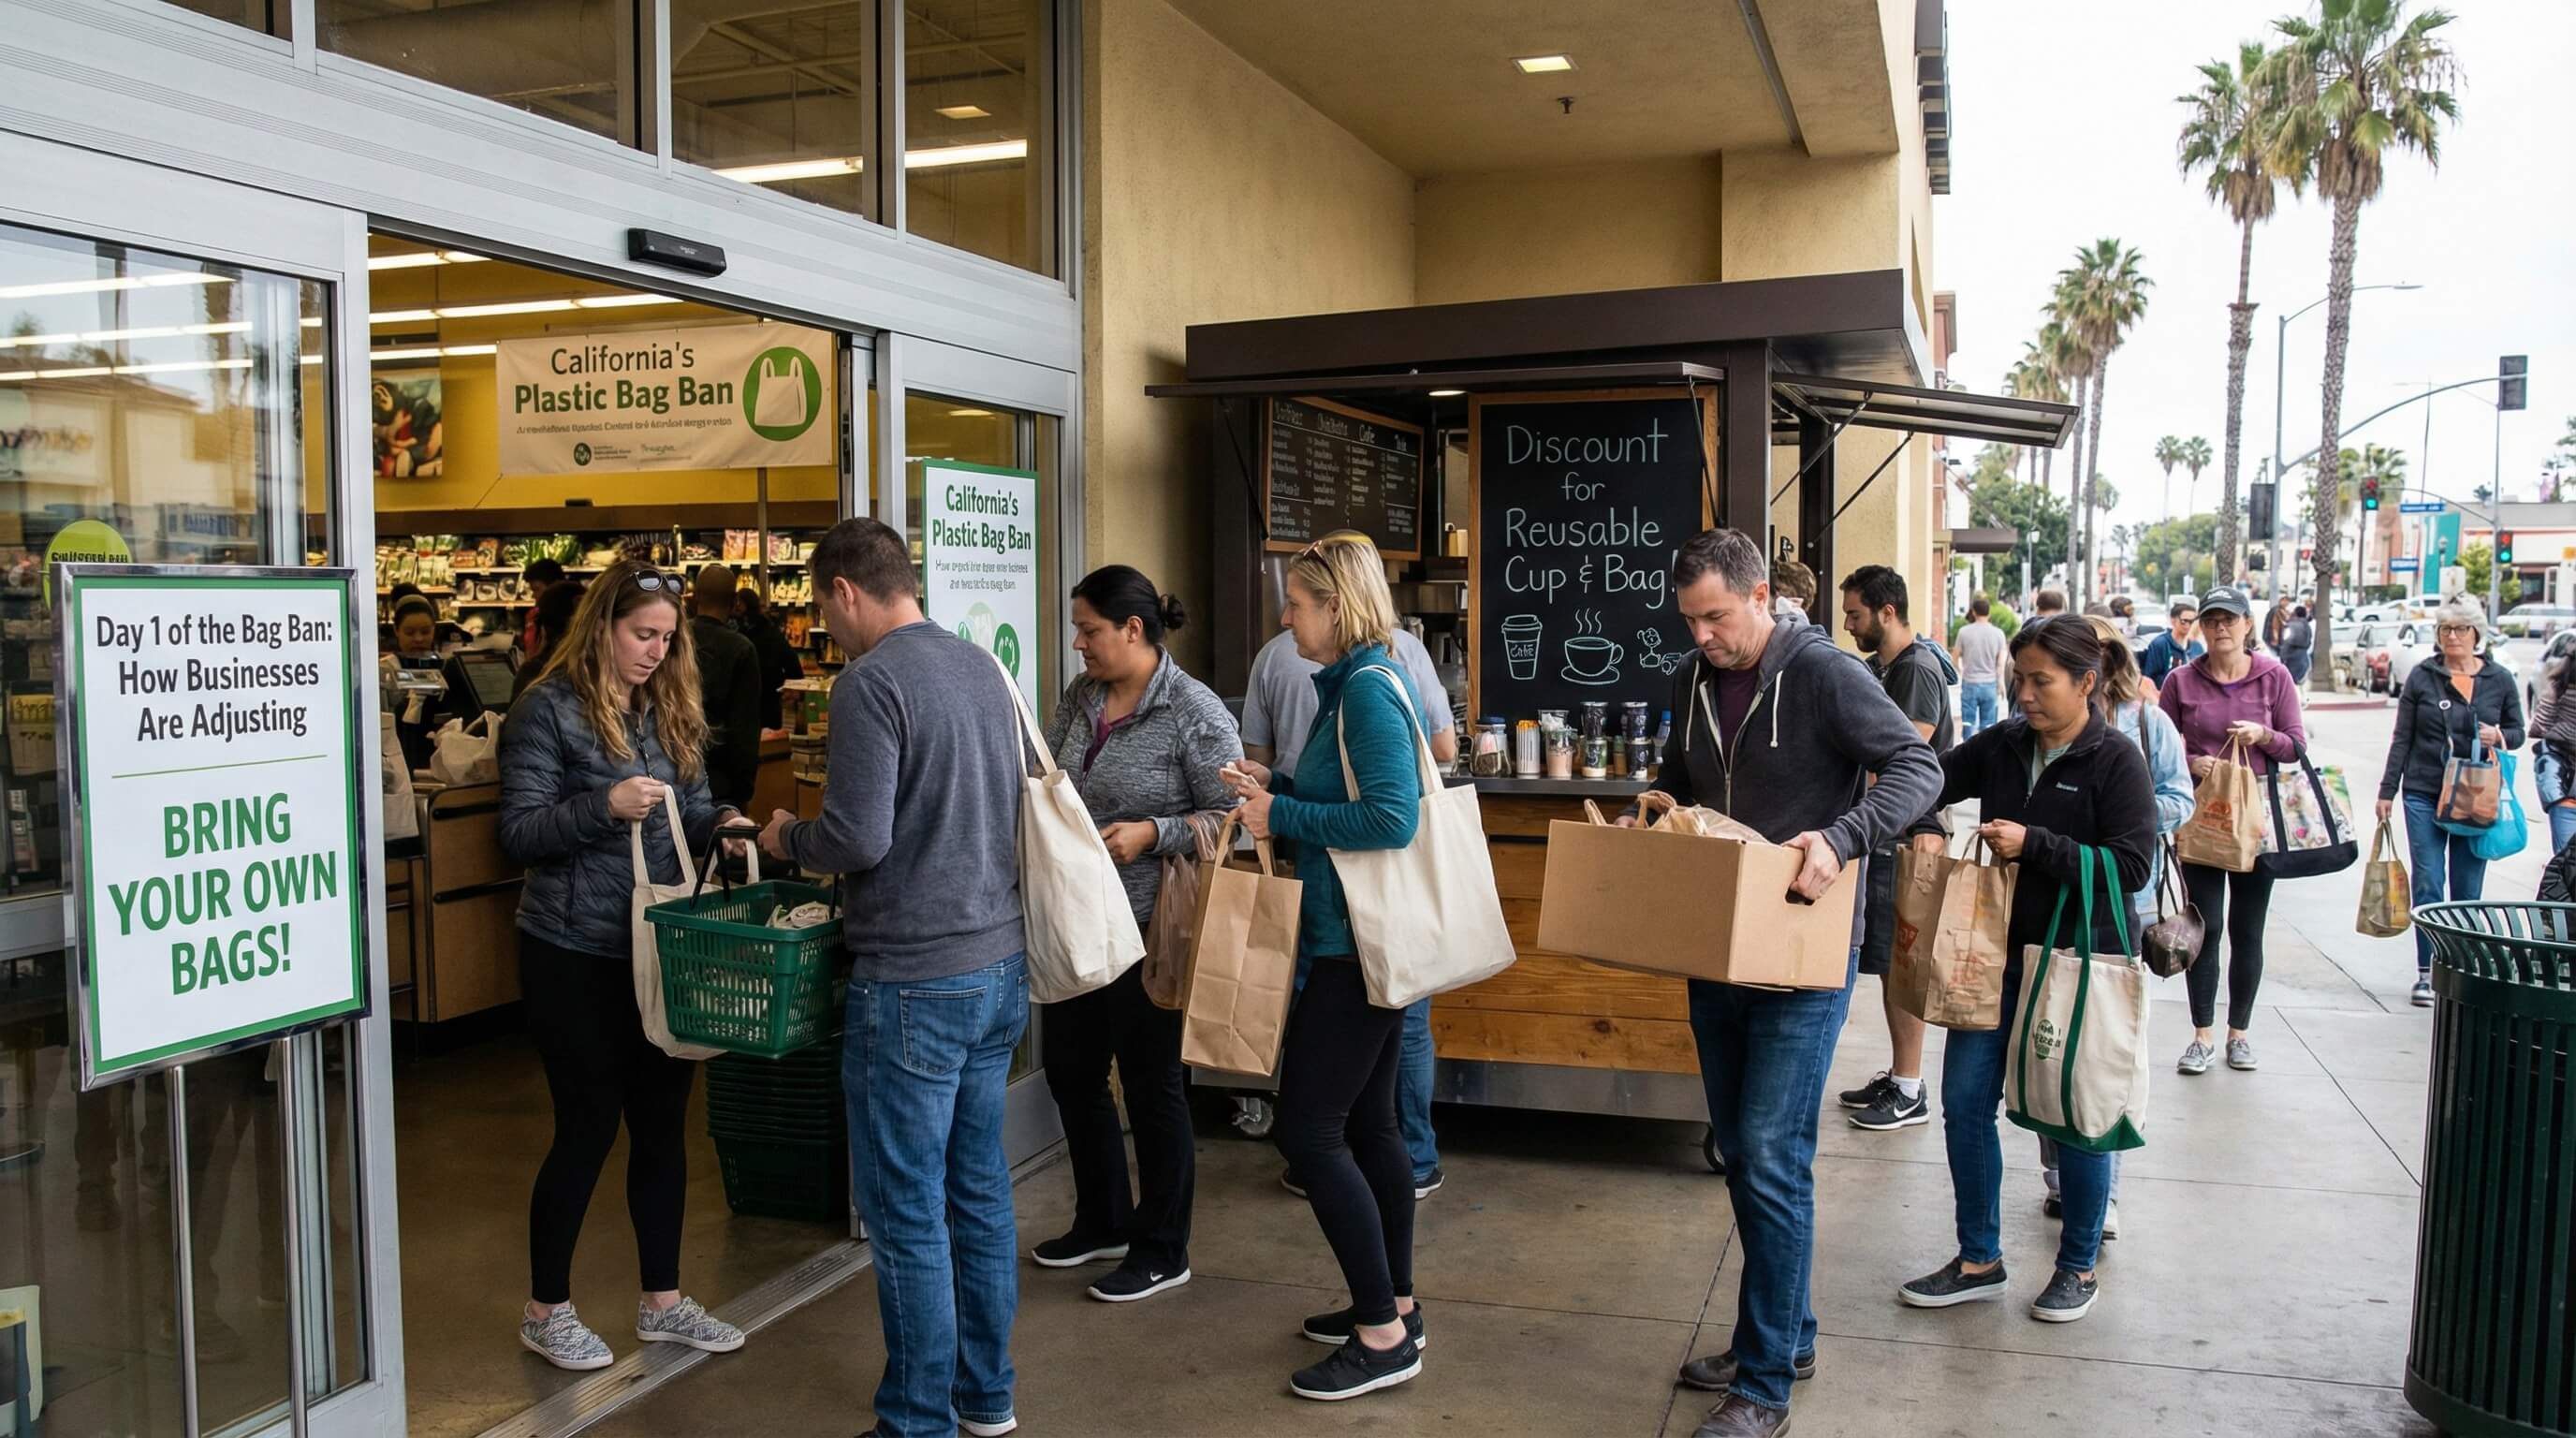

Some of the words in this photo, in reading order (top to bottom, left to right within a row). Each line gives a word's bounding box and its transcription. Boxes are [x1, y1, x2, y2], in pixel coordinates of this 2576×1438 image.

[551, 342, 695, 375] California's
[515, 381, 607, 414] Plastic
[616, 379, 670, 415] Bag
[679, 376, 734, 407] Ban
[1507, 418, 1669, 464] Discount
[945, 484, 1018, 516] California's
[1560, 471, 1605, 502] for
[932, 519, 978, 548] Plastic
[981, 521, 1005, 554] Bag
[1008, 523, 1032, 550] Ban
[1506, 506, 1663, 548] Reusable
[1505, 555, 1567, 605] Cup
[1579, 554, 1593, 594] &
[1605, 550, 1678, 609] Bag!
[96, 615, 144, 654] Day
[150, 615, 160, 646] 1
[168, 613, 193, 646] of
[198, 613, 235, 645] the
[242, 613, 282, 650] Bag
[287, 613, 332, 643] Ban:
[119, 660, 179, 696] How
[186, 656, 319, 692] Businesses
[137, 707, 183, 742] Are
[190, 699, 307, 743] Adjusting
[163, 792, 291, 858] BRING
[108, 867, 232, 936] YOUR
[243, 851, 338, 914] OWN
[170, 922, 291, 996] BAGS!
